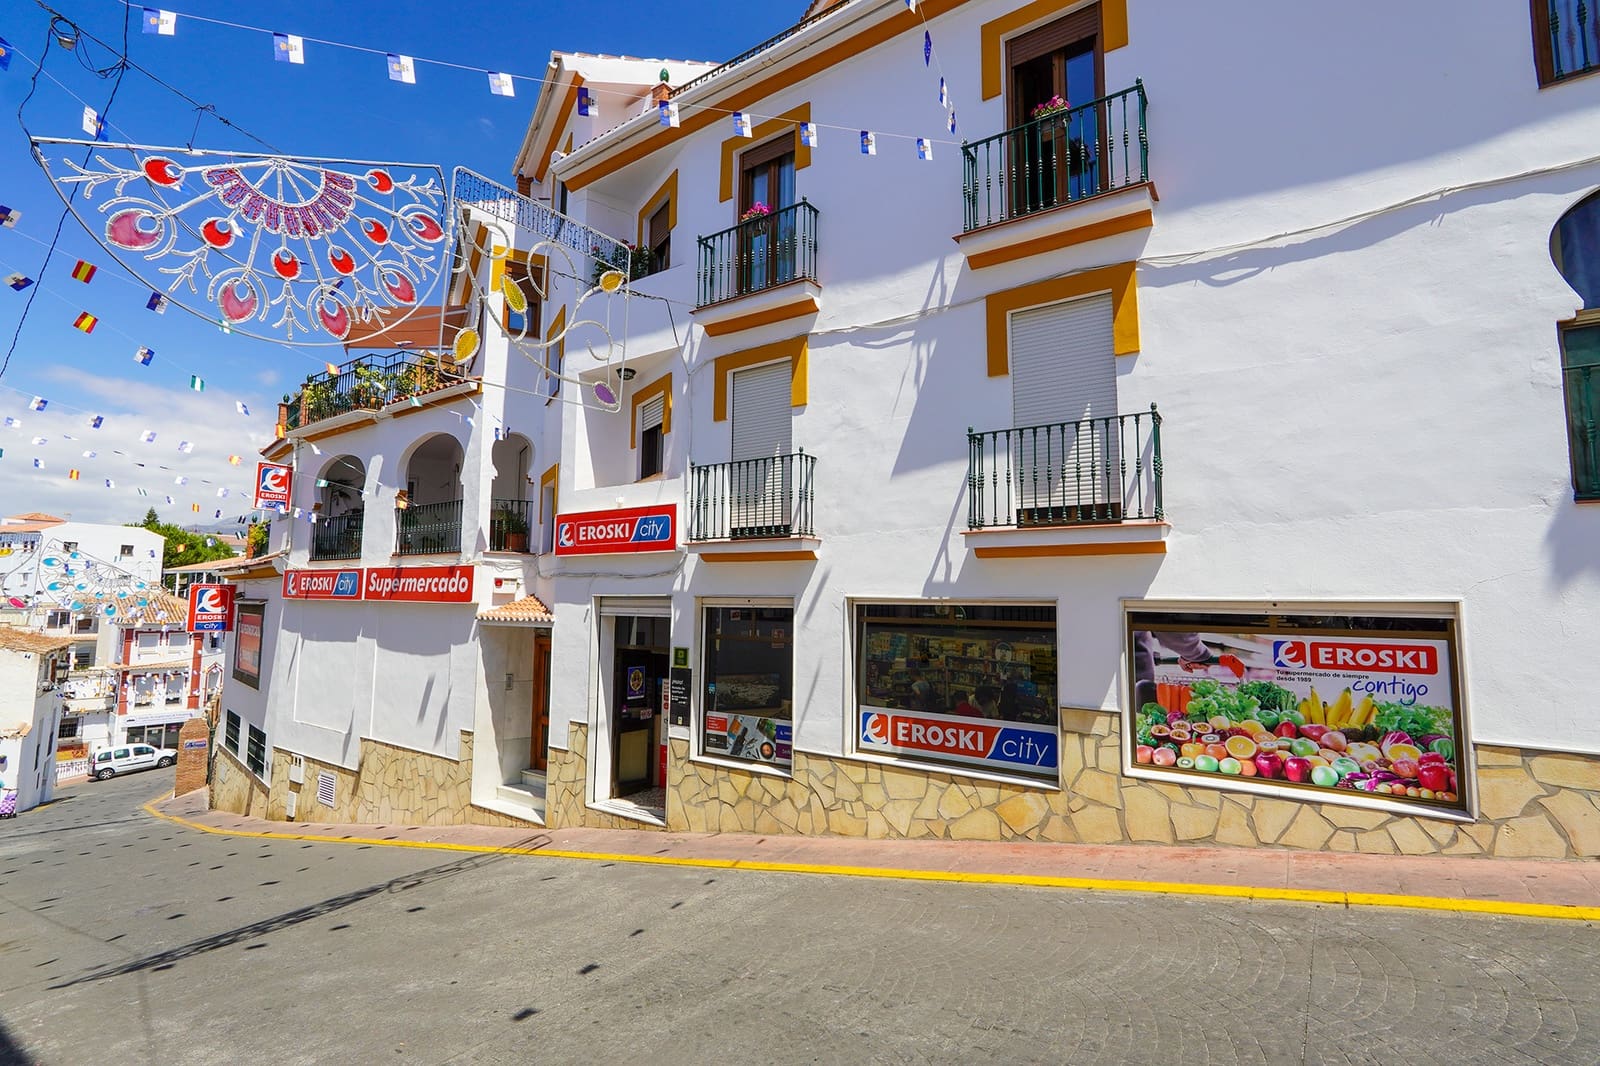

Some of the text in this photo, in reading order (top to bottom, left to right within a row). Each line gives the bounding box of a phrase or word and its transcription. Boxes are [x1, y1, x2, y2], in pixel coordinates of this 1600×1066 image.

[260, 492, 286, 500] EROSKI
[578, 519, 664, 541] EROSKI city
[300, 575, 354, 593] EROSKI city
[368, 570, 468, 597] Supermercado
[203, 622, 219, 630] city
[1318, 647, 1428, 669] EROSKI
[1284, 670, 1331, 678] supermercado
[1352, 675, 1429, 706] contigo
[896, 721, 1049, 766] EROSKI city
